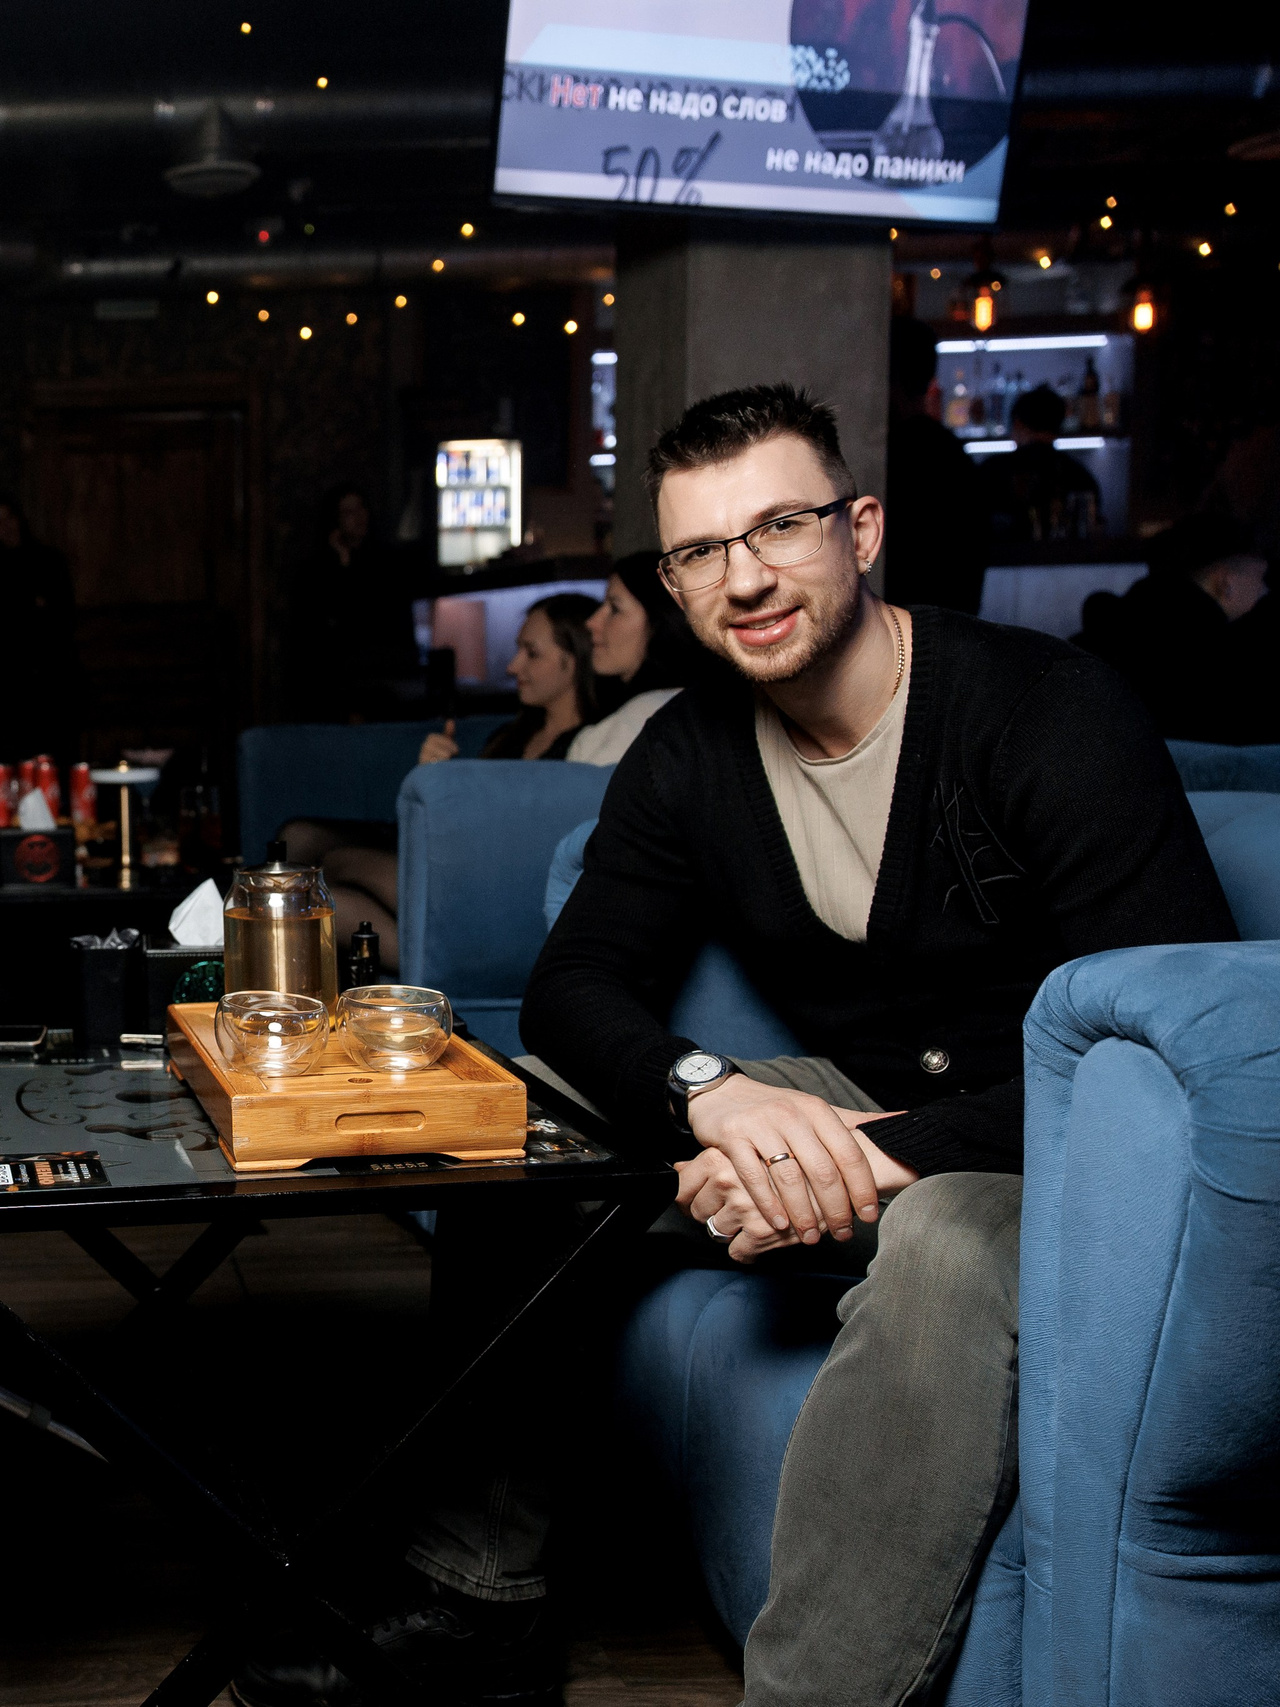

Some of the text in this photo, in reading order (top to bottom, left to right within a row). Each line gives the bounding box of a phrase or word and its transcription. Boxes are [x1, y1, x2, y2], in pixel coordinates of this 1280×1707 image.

[549, 74, 604, 110] Нет
[608, 86, 643, 112] не
[649, 88, 717, 121] надо
[722, 95, 788, 123] слов
[766, 147, 966, 184] не надо паники
